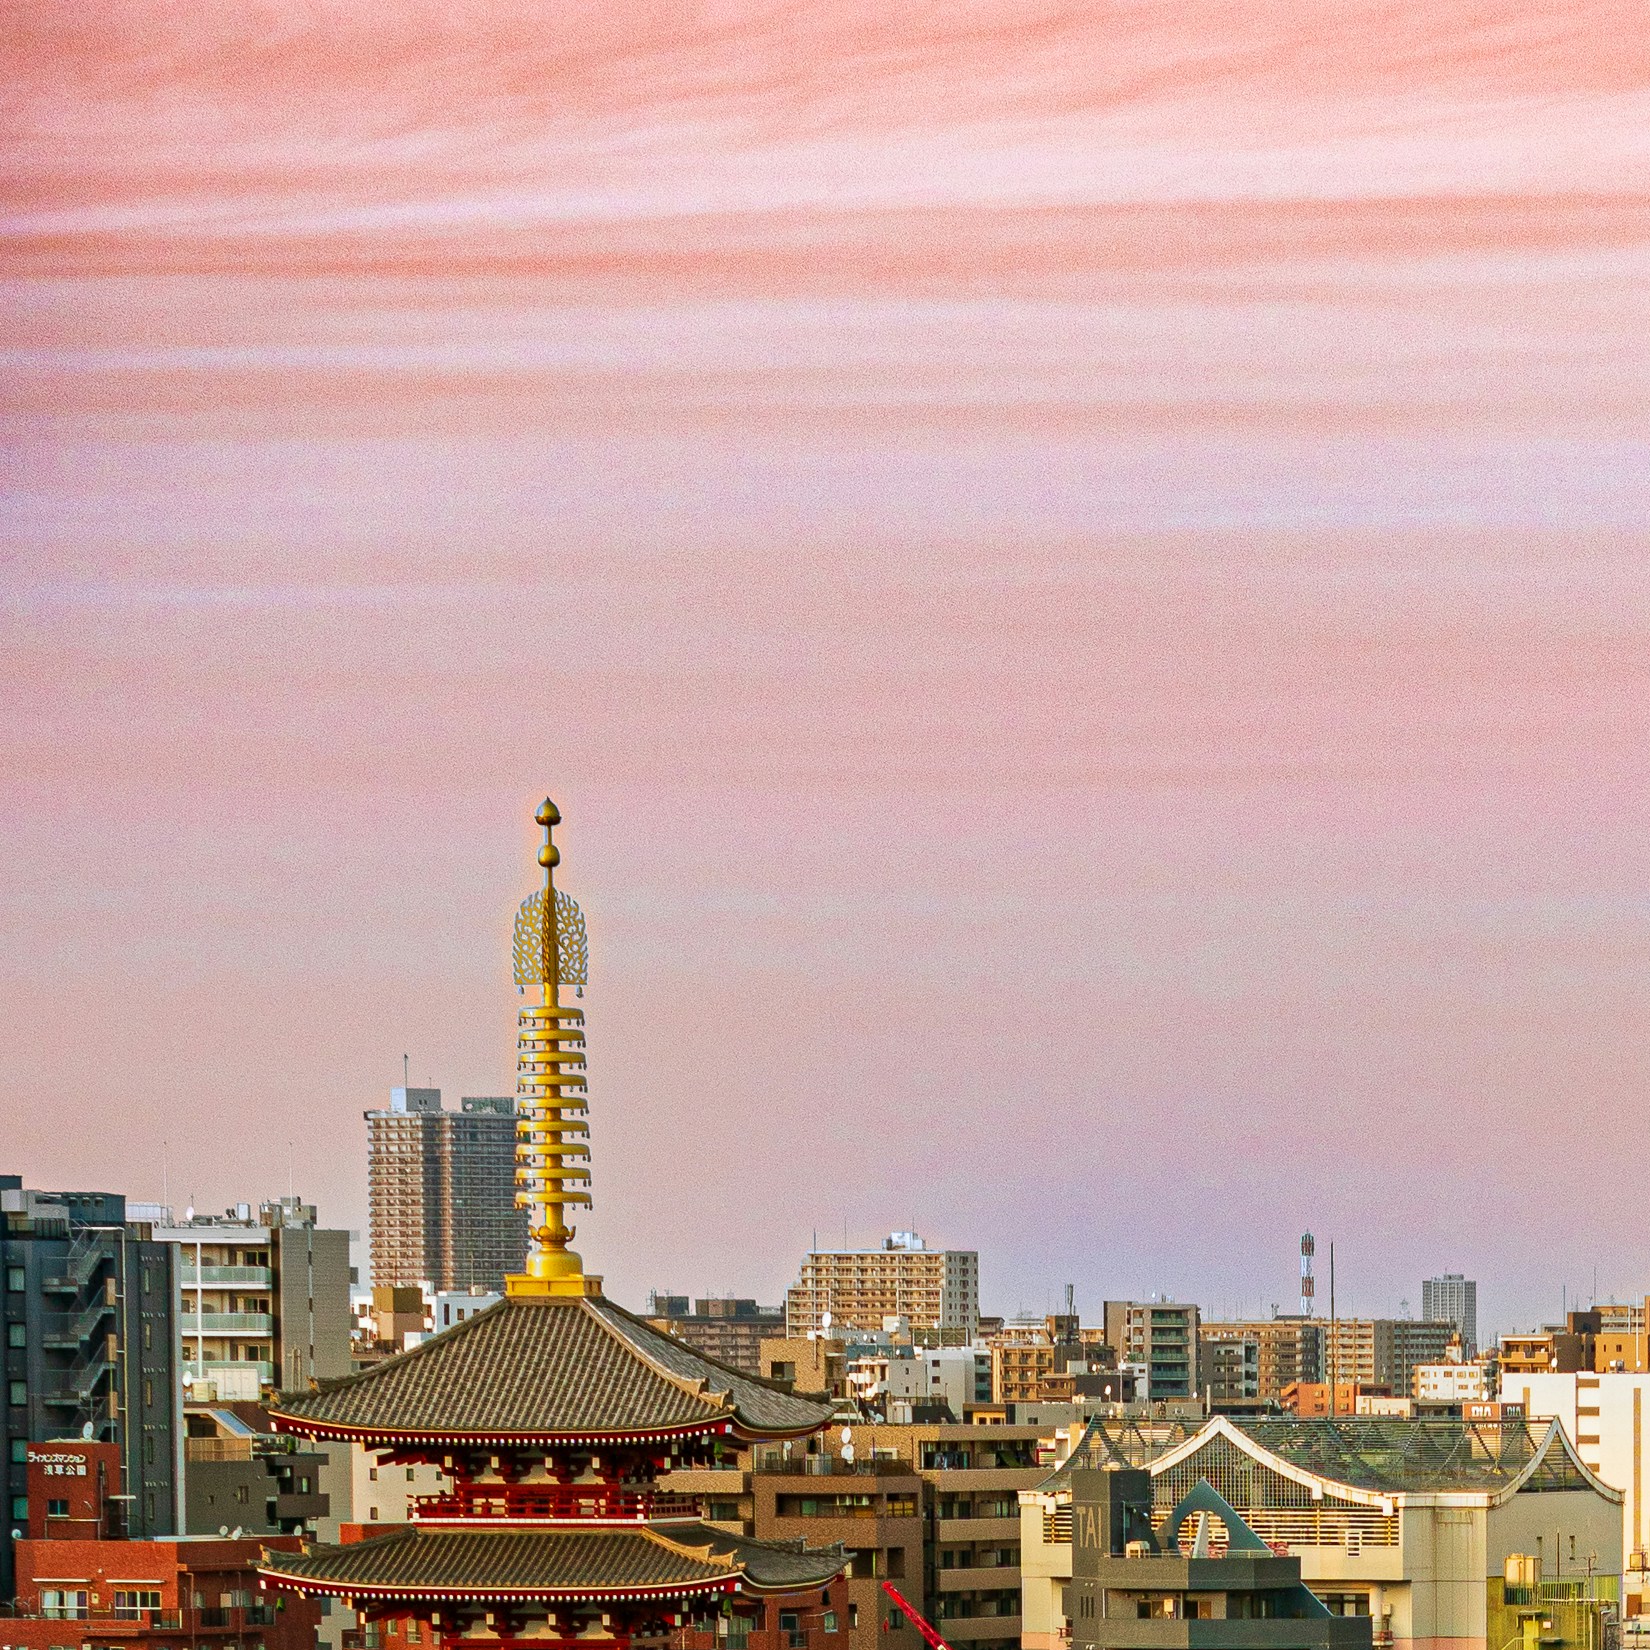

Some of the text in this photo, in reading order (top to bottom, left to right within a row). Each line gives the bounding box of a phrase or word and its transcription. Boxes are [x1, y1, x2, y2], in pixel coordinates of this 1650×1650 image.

[1471, 1406, 1492, 1417] DIA
[28, 1451, 86, 1463] ライオンズマンション
[44, 1465, 86, 1475] 浅草公園
